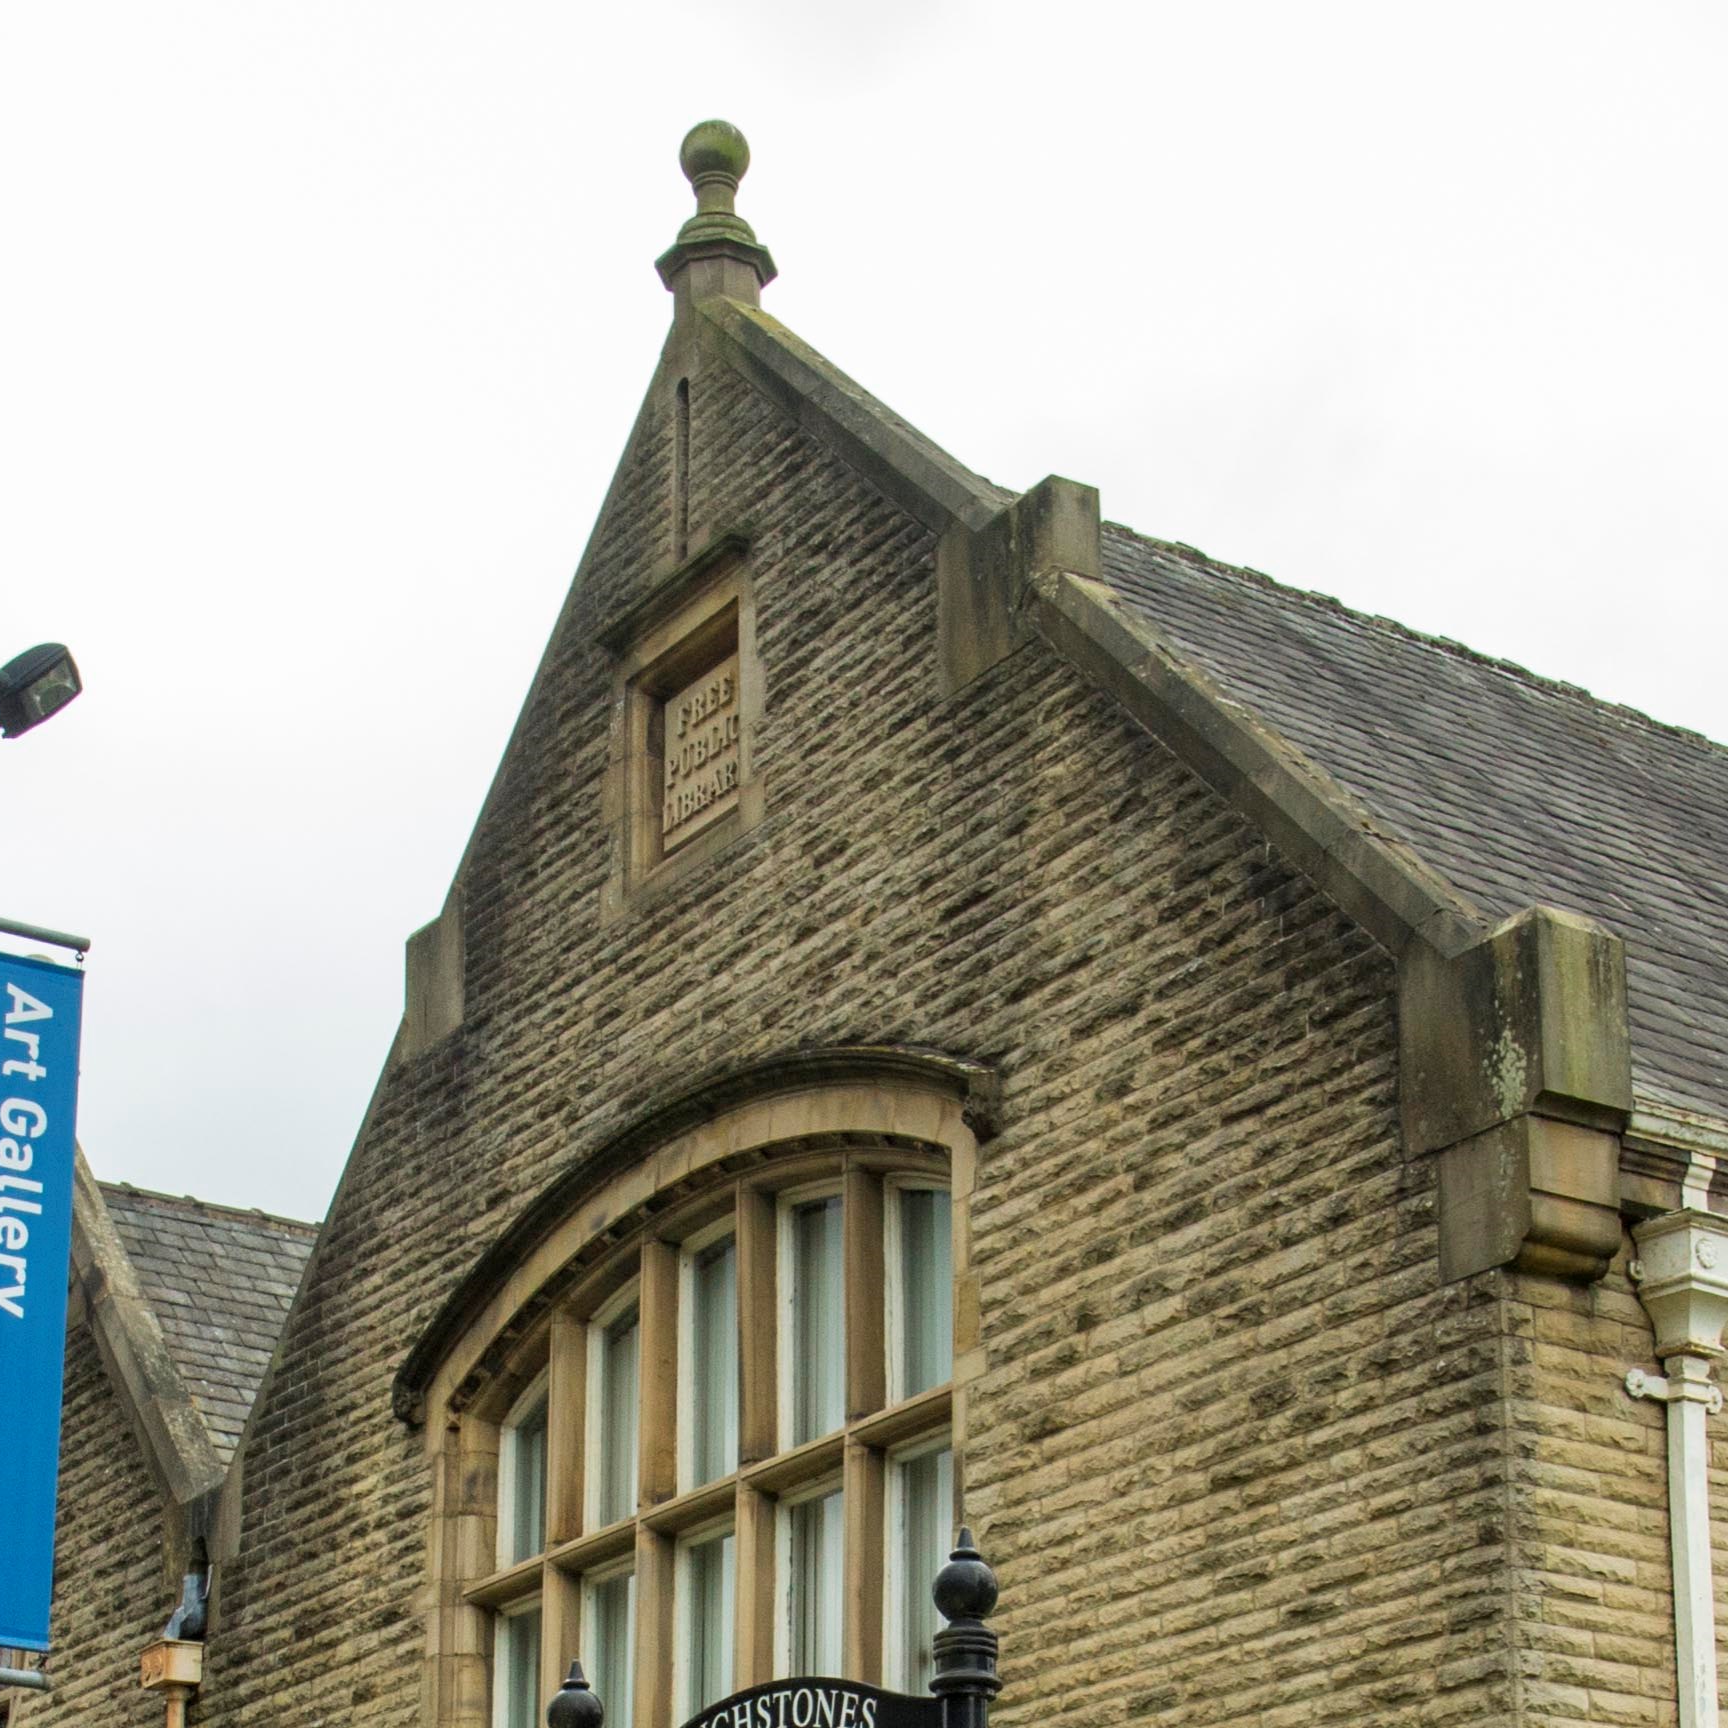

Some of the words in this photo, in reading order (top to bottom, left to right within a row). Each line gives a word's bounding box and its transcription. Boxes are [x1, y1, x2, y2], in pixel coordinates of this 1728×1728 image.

[677, 672, 735, 738] FREE
[666, 713, 739, 789] PUBLIC
[662, 760, 739, 836] LIBRAR
[1, 982, 54, 1082] Art
